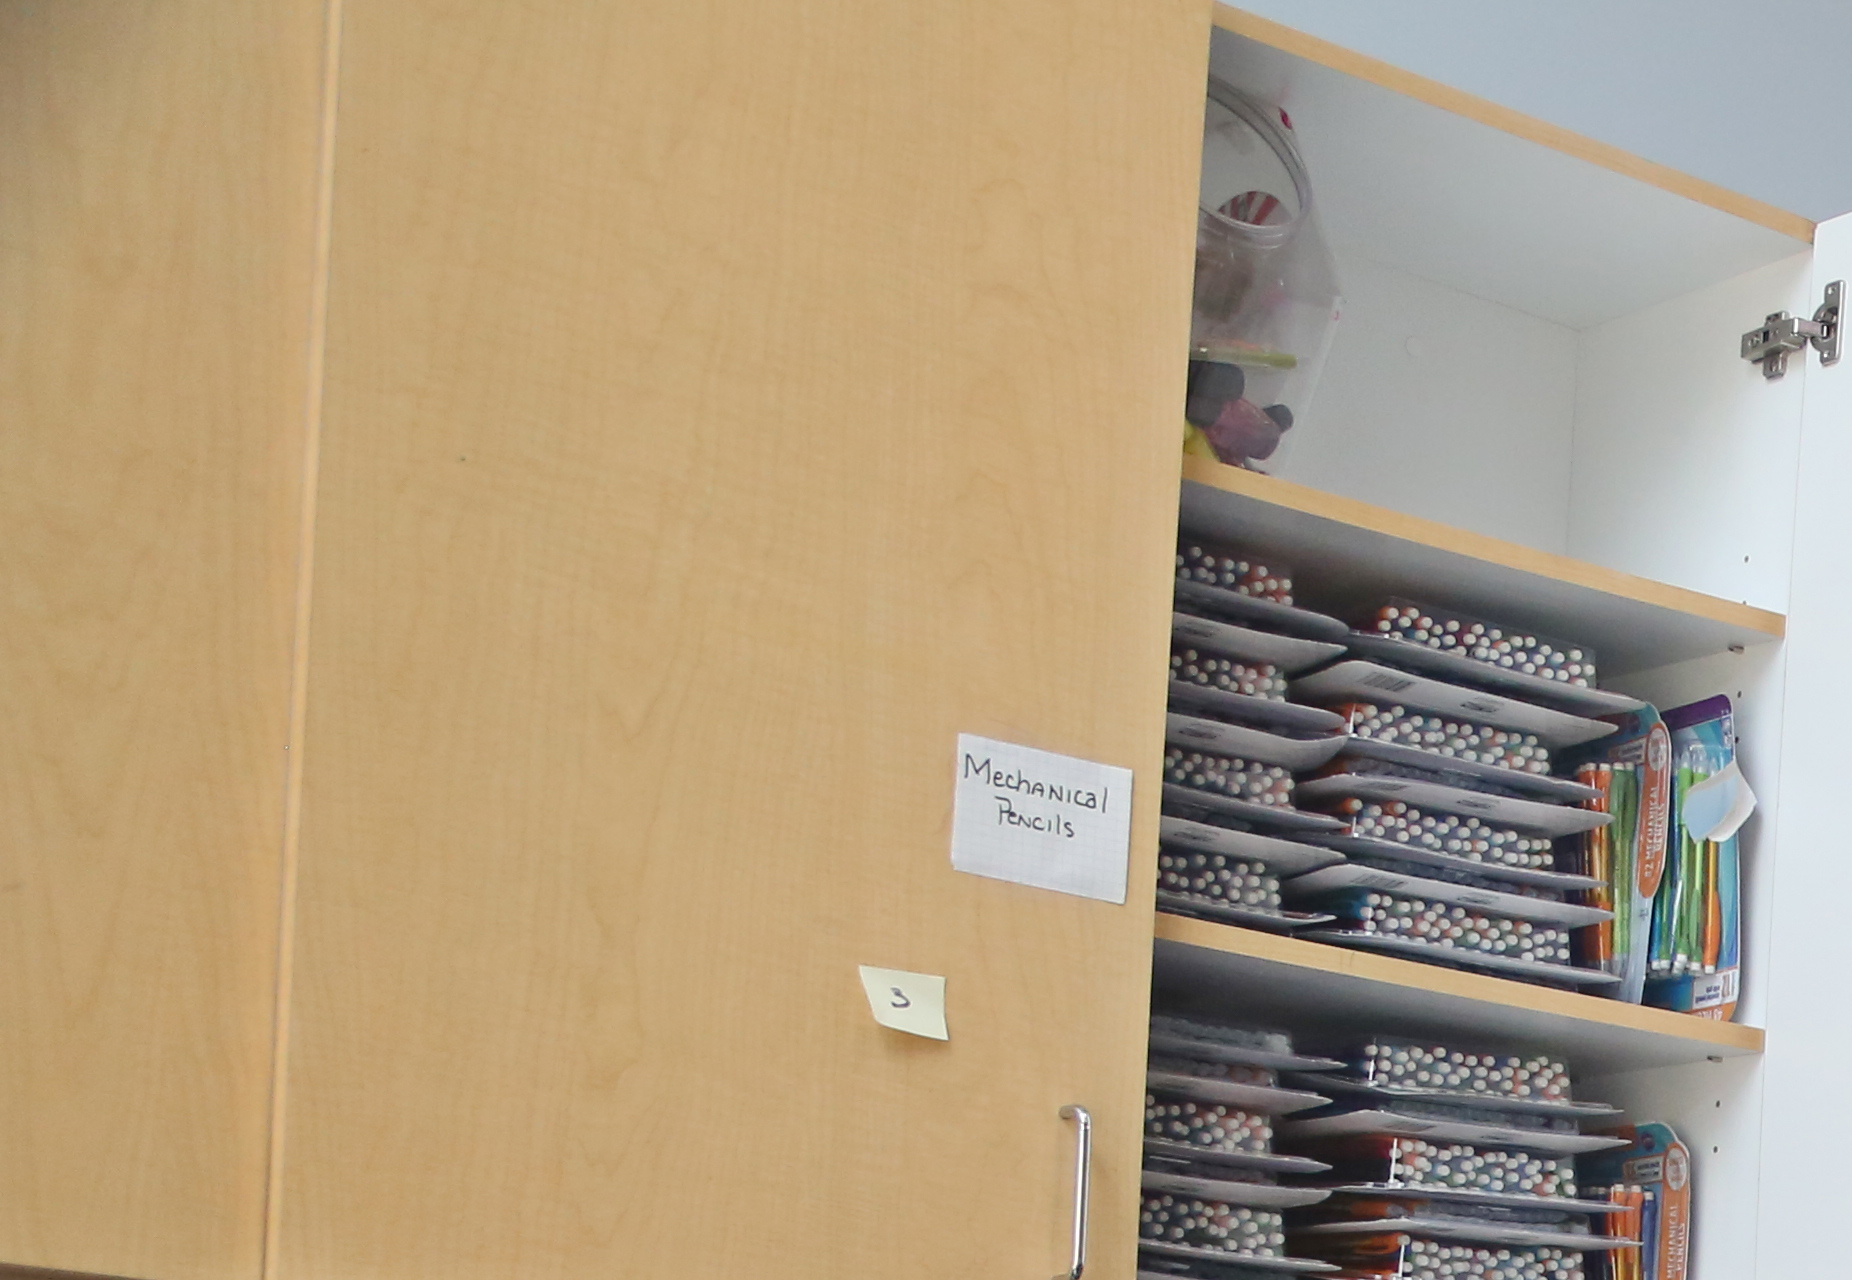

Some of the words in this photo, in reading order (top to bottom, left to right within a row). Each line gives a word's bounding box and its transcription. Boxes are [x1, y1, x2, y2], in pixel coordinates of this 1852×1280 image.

[964, 754, 1108, 814] Mechanical
[995, 796, 1075, 838] Pencils
[890, 987, 911, 1009] 3
[1667, 1203, 1680, 1278] MECHANICAL
